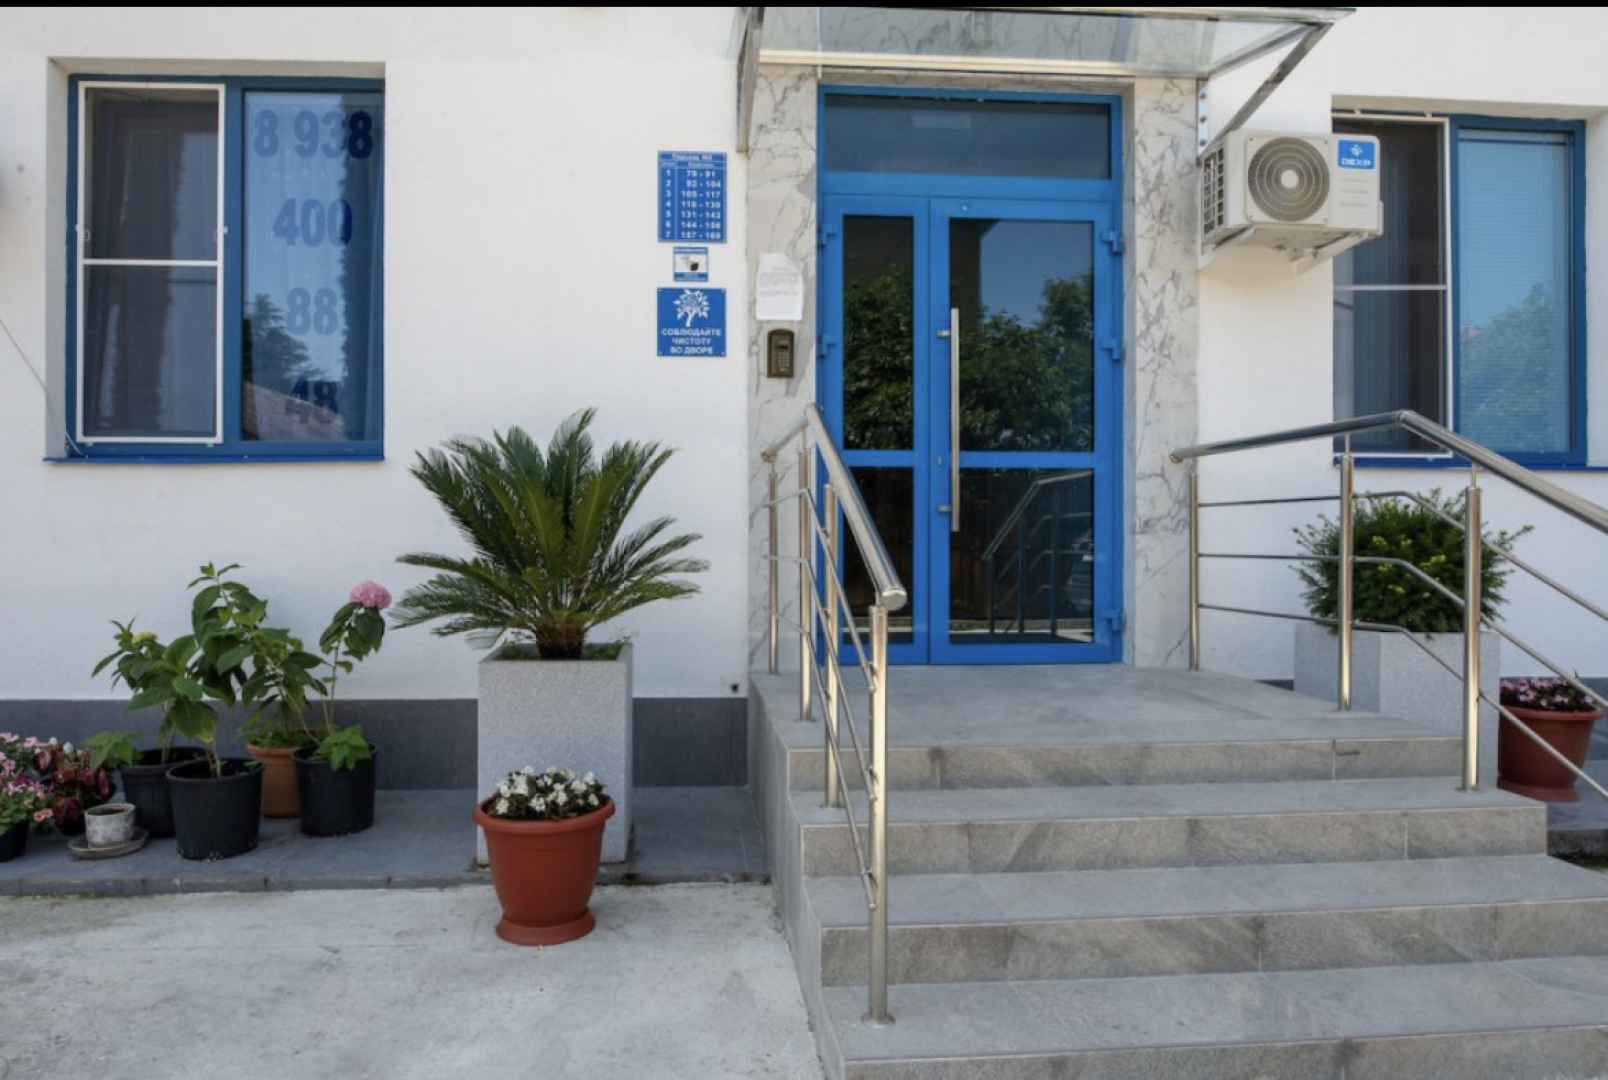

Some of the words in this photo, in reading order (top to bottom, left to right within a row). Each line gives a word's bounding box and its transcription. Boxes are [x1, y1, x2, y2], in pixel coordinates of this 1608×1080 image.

[254, 109, 279, 159] 8
[293, 109, 373, 159] 938
[1341, 157, 1371, 166] DEXP
[272, 198, 353, 247] 400
[286, 286, 339, 335] 88
[661, 328, 721, 336] СОБЛЮДАЙТЕ
[670, 346, 682, 354] ВО
[684, 346, 713, 354] ДВОРЕ
[285, 374, 339, 424] 48
